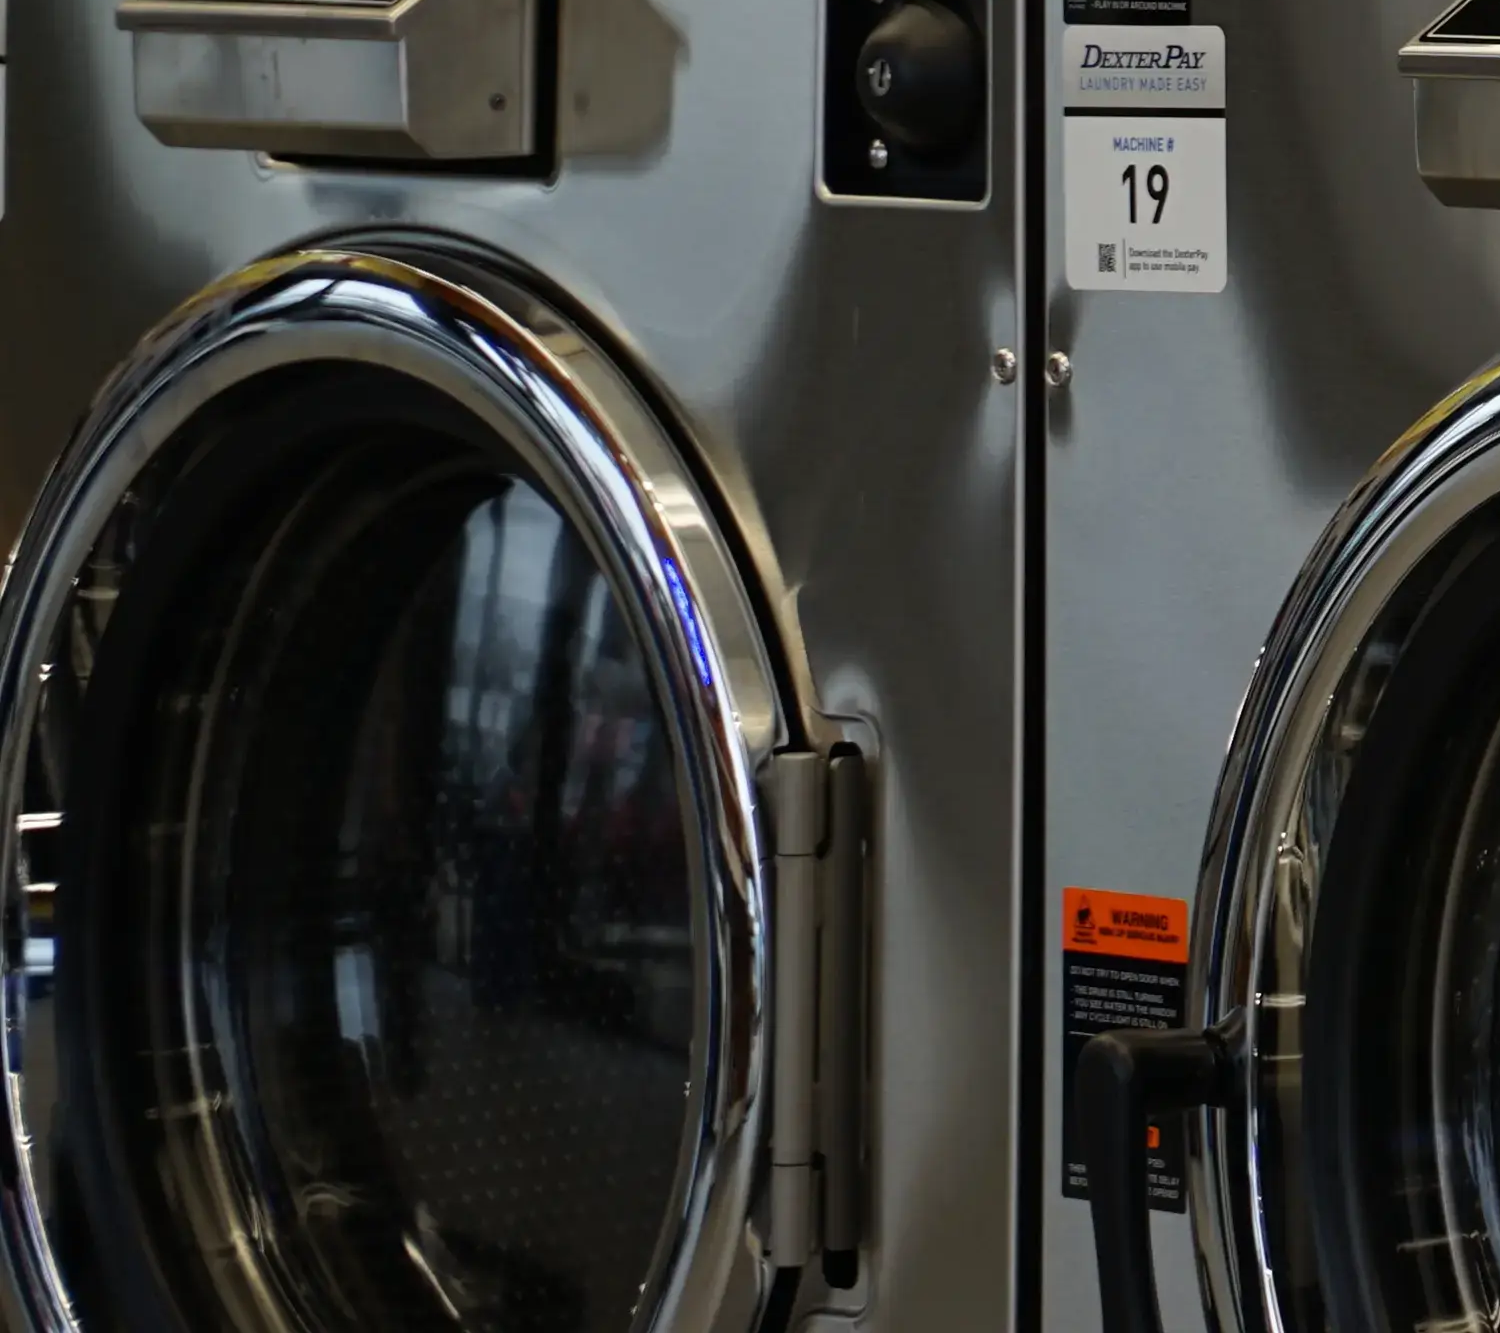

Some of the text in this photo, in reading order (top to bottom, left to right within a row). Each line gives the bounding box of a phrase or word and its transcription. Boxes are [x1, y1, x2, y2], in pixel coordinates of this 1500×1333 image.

[1080, 76, 1207, 92] LAUNDRY MADE EASY
[1113, 136, 1175, 152] MACHINE #
[1122, 164, 1169, 224] 19
[1110, 908, 1168, 931] WARNING
